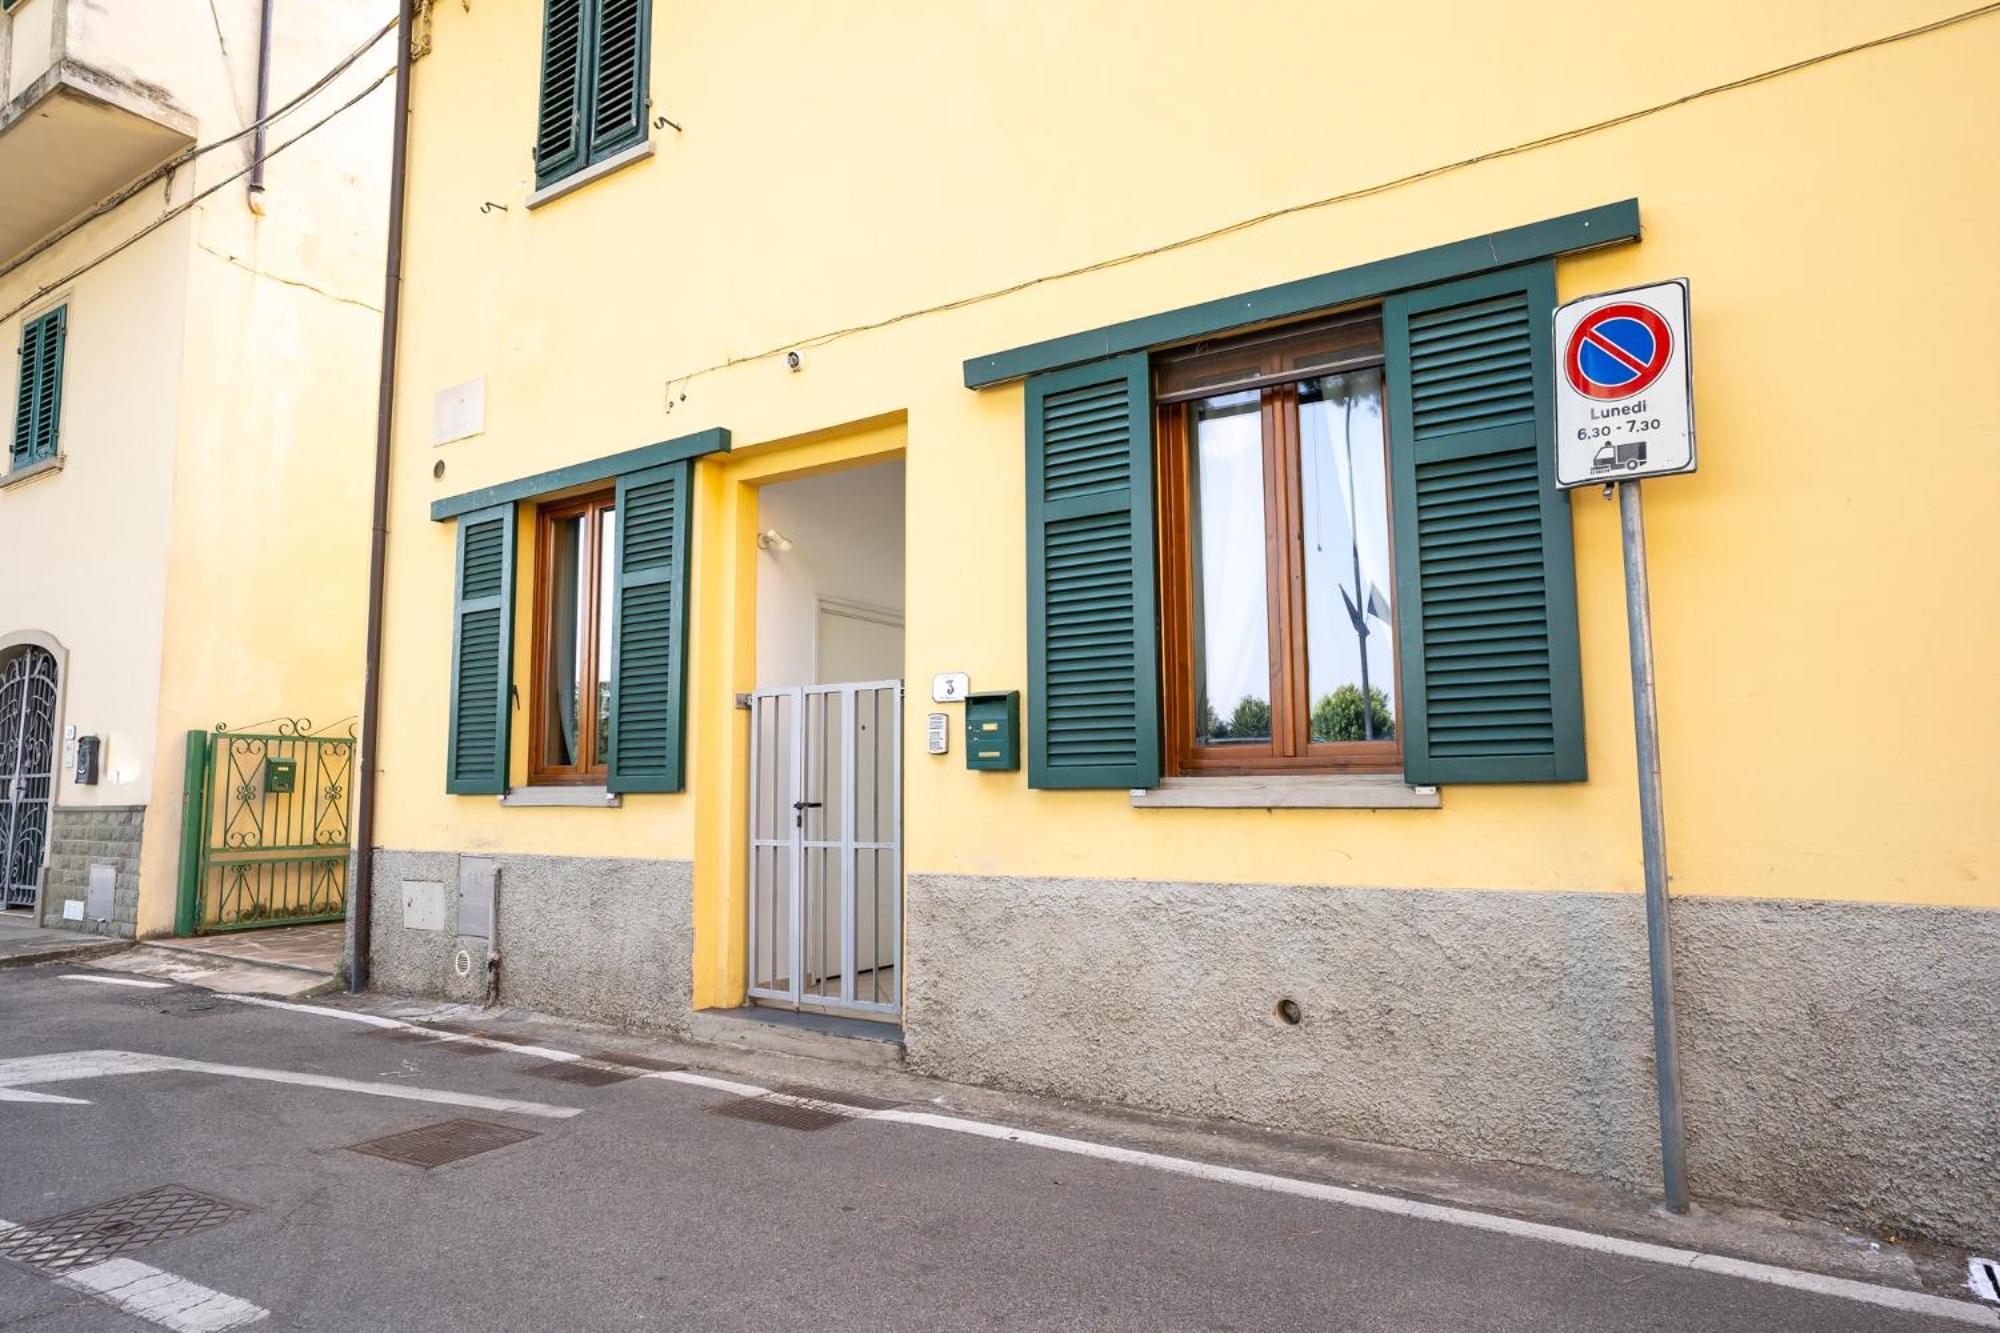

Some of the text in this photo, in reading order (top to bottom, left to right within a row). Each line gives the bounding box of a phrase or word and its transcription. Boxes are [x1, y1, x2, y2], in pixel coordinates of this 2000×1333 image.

[1591, 400, 1646, 420] Lunedi
[1577, 425, 1611, 441] 6.30
[1626, 418, 1661, 433] 7.30
[945, 679, 955, 695] 3
